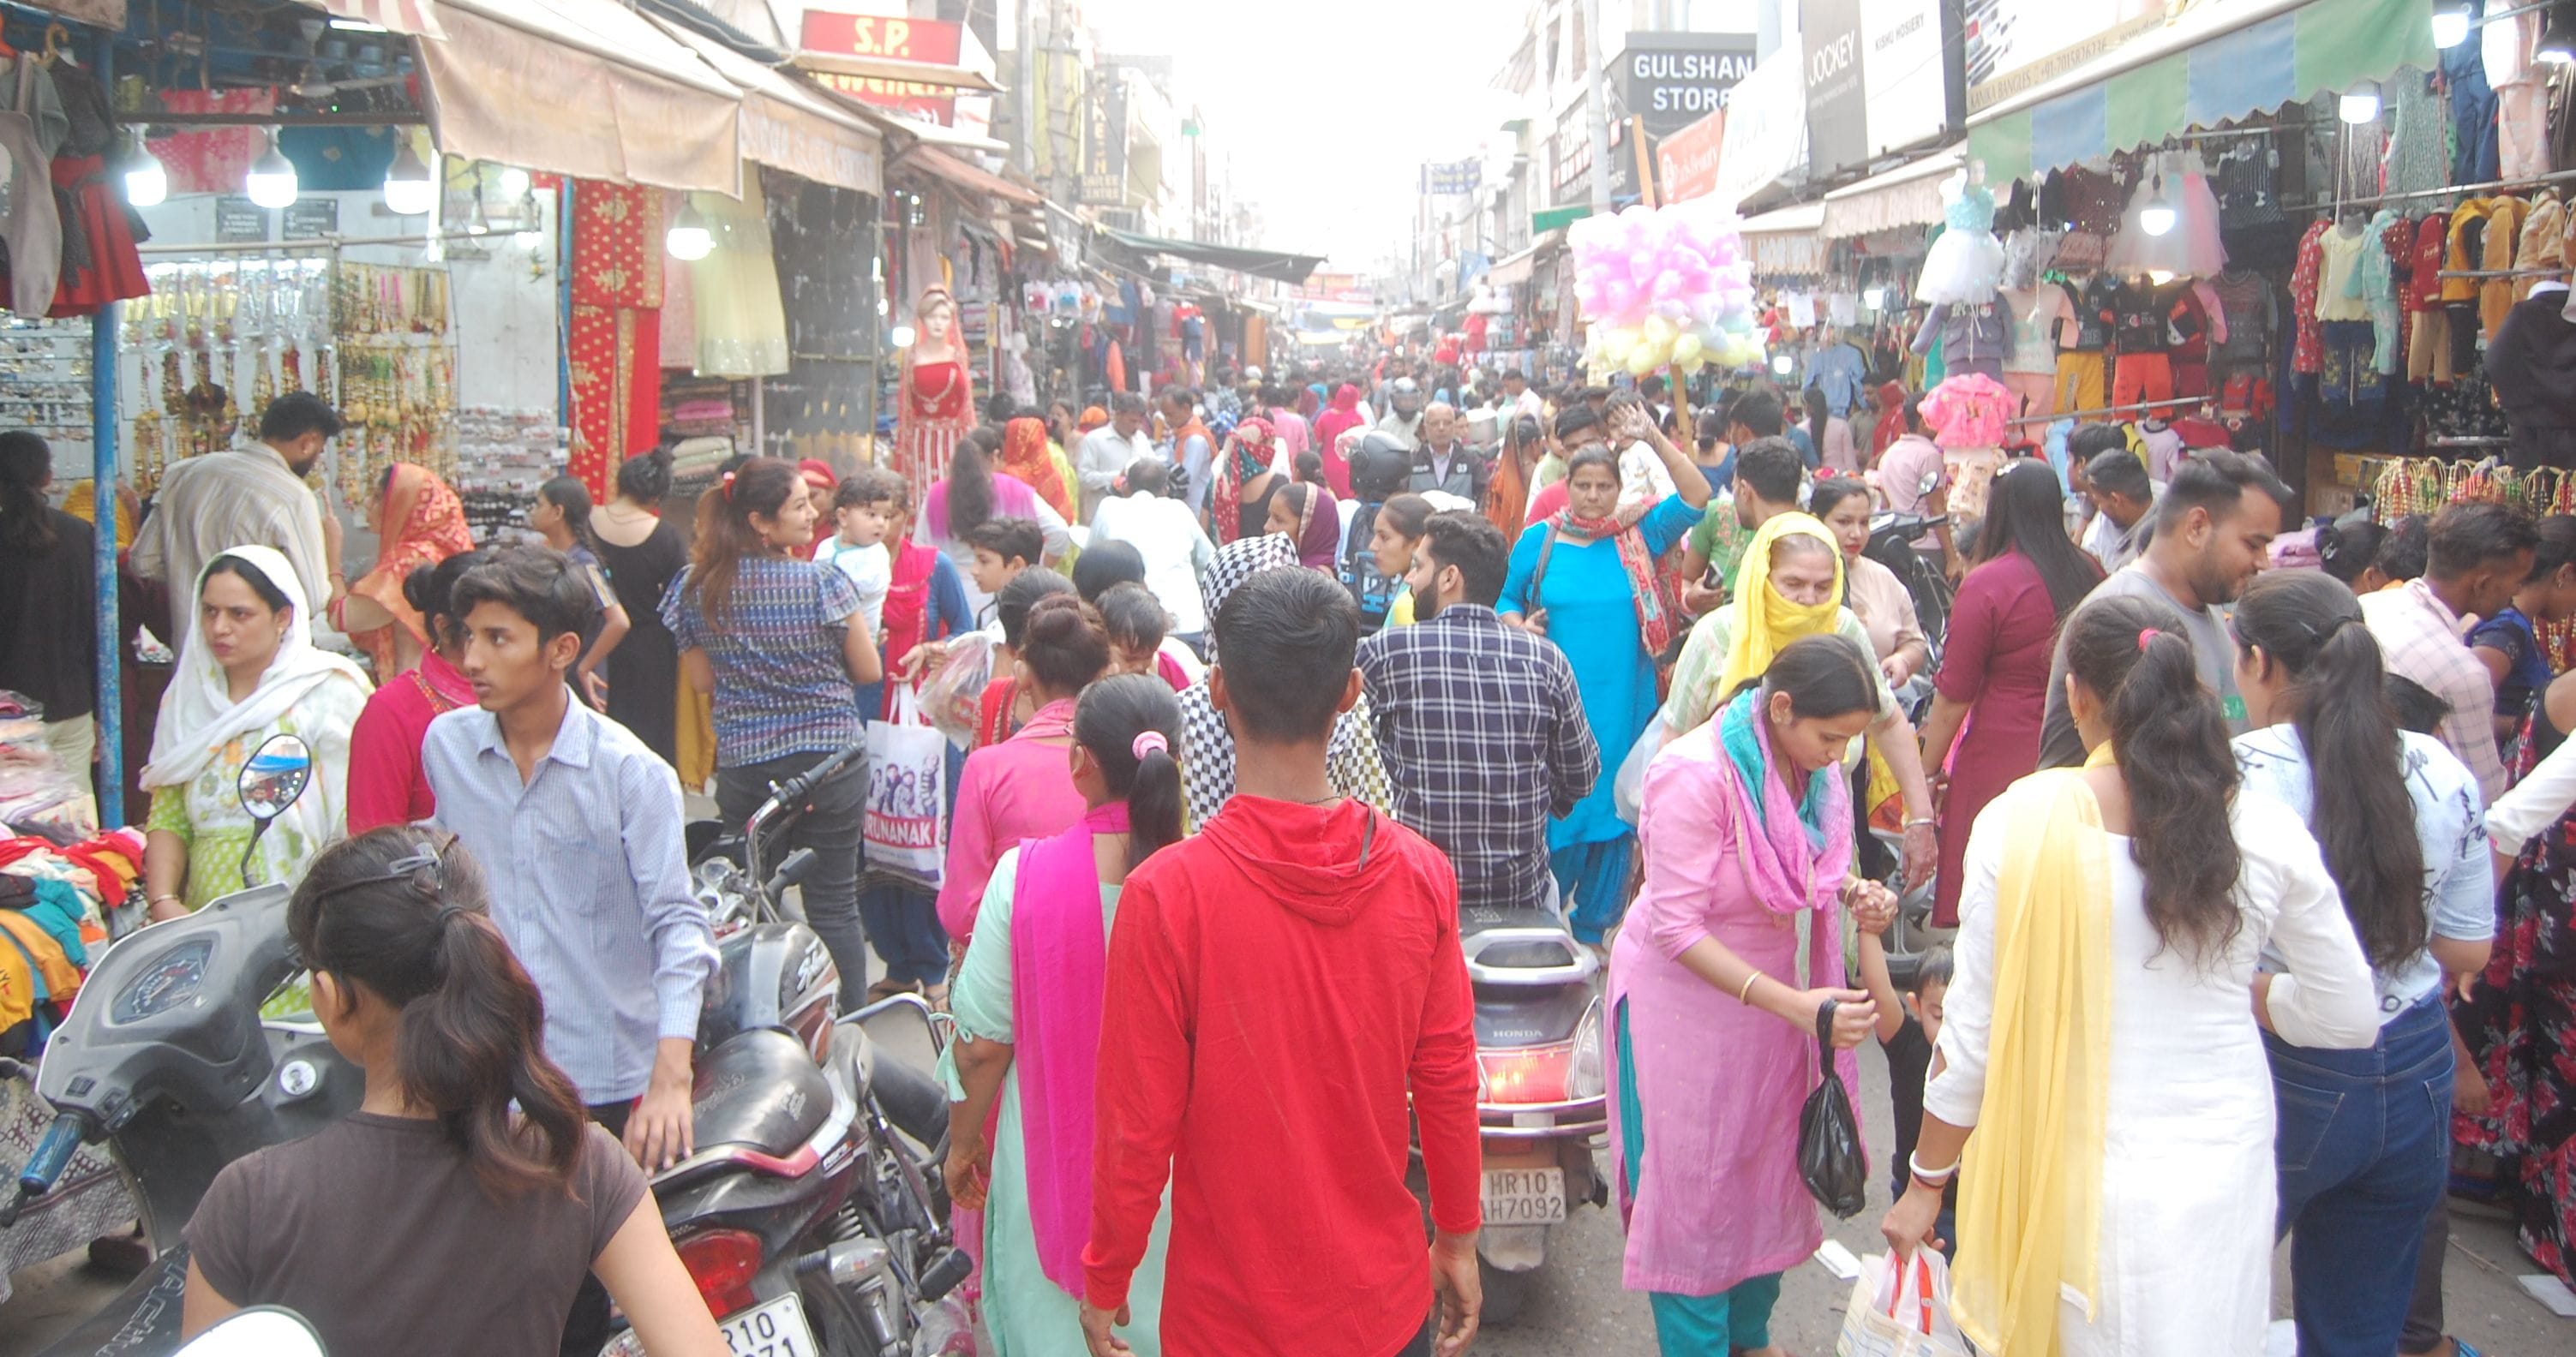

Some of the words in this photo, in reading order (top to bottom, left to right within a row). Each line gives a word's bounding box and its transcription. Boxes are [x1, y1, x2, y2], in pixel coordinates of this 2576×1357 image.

[854, 17, 909, 57] S.P.
[1896, 12, 1925, 41] HOSIERY
[1633, 54, 1752, 79] GULSHAN
[1809, 30, 1854, 87] JOCKEY
[808, 72, 955, 96] ewellers
[1493, 1029, 1543, 1038] HONDA
[721, 1312, 776, 1354] R10
